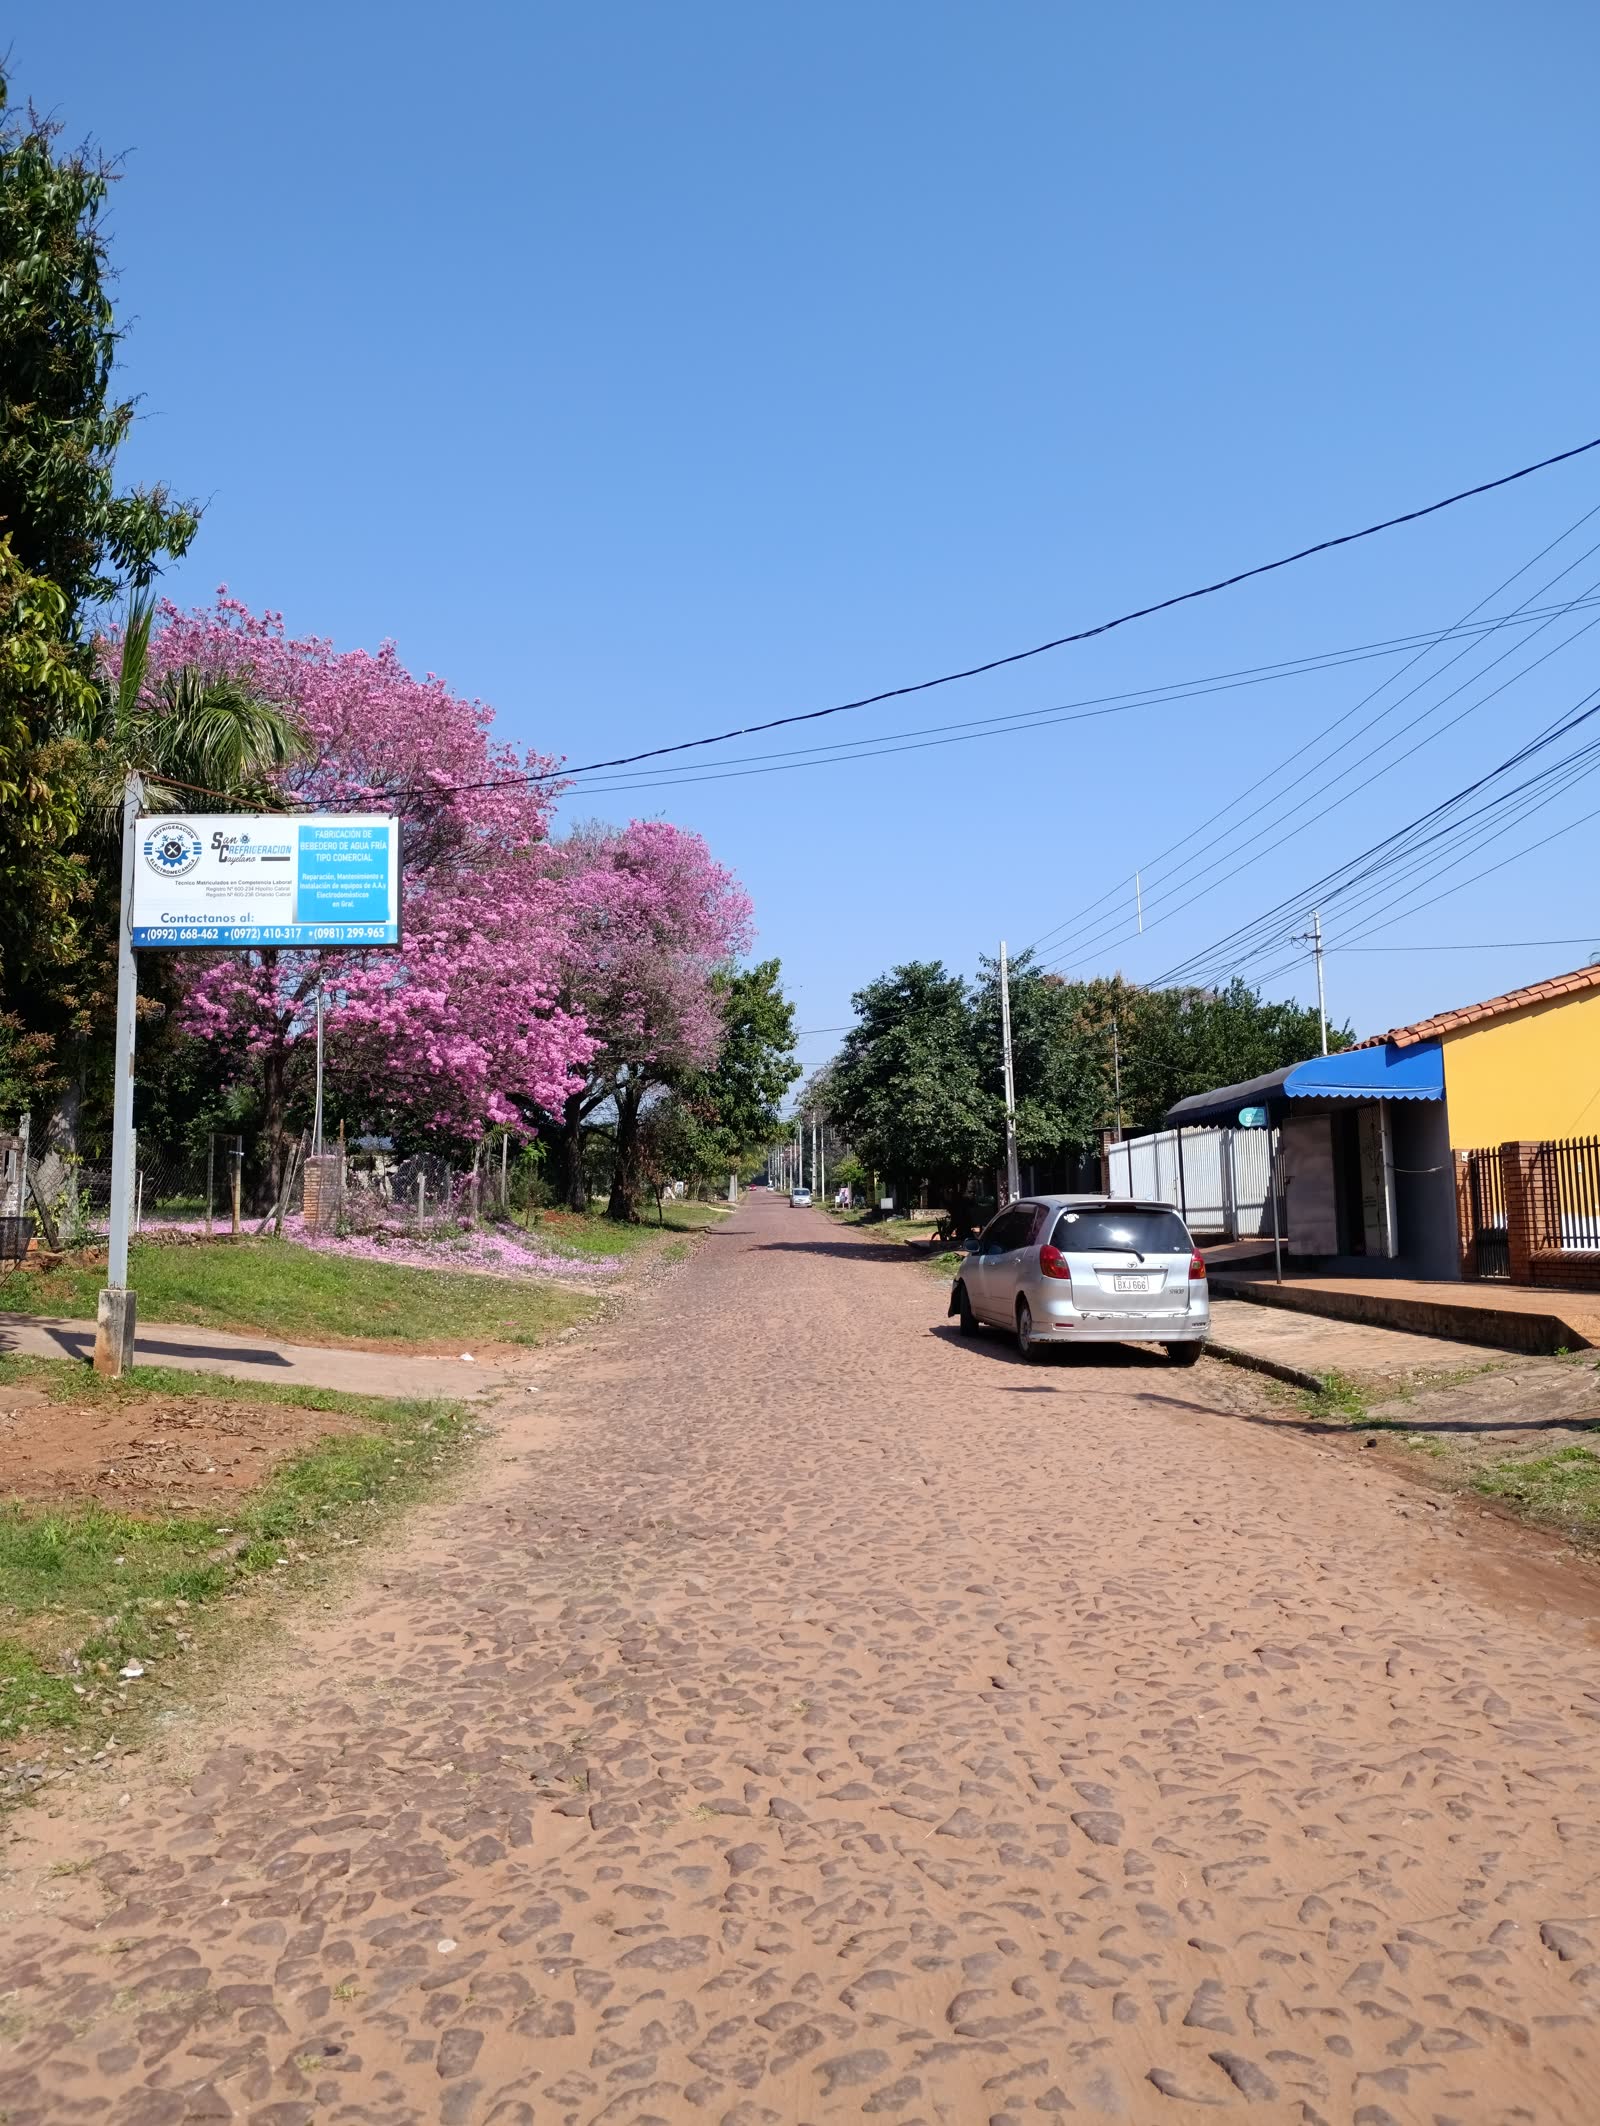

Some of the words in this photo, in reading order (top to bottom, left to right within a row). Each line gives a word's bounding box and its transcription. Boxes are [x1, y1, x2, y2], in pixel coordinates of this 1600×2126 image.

[315, 828, 361, 839] FABRICACIÓN
[363, 830, 372, 838] DE
[211, 831, 239, 850] San
[300, 841, 338, 851] BEBEDERO
[339, 841, 349, 850] DE
[350, 841, 370, 850] AGUA
[371, 840, 387, 849] FRÍA
[218, 844, 256, 866] Cayetano
[315, 853, 331, 862] TIPO
[333, 853, 373, 862] COMERCIAL
[340, 882, 362, 890] equipos
[160, 912, 236, 924] Contactanos
[239, 912, 255, 923] al:
[147, 928, 178, 941] (0992)
[180, 928, 218, 940] 668-462
[230, 927, 261, 941] (0972)
[263, 928, 301, 939] 410-317
[314, 927, 344, 940] (0981)
[346, 927, 385, 938] 299-965
[1117, 1280, 1131, 1290] BXJ
[1132, 1280, 1146, 1290] 666
